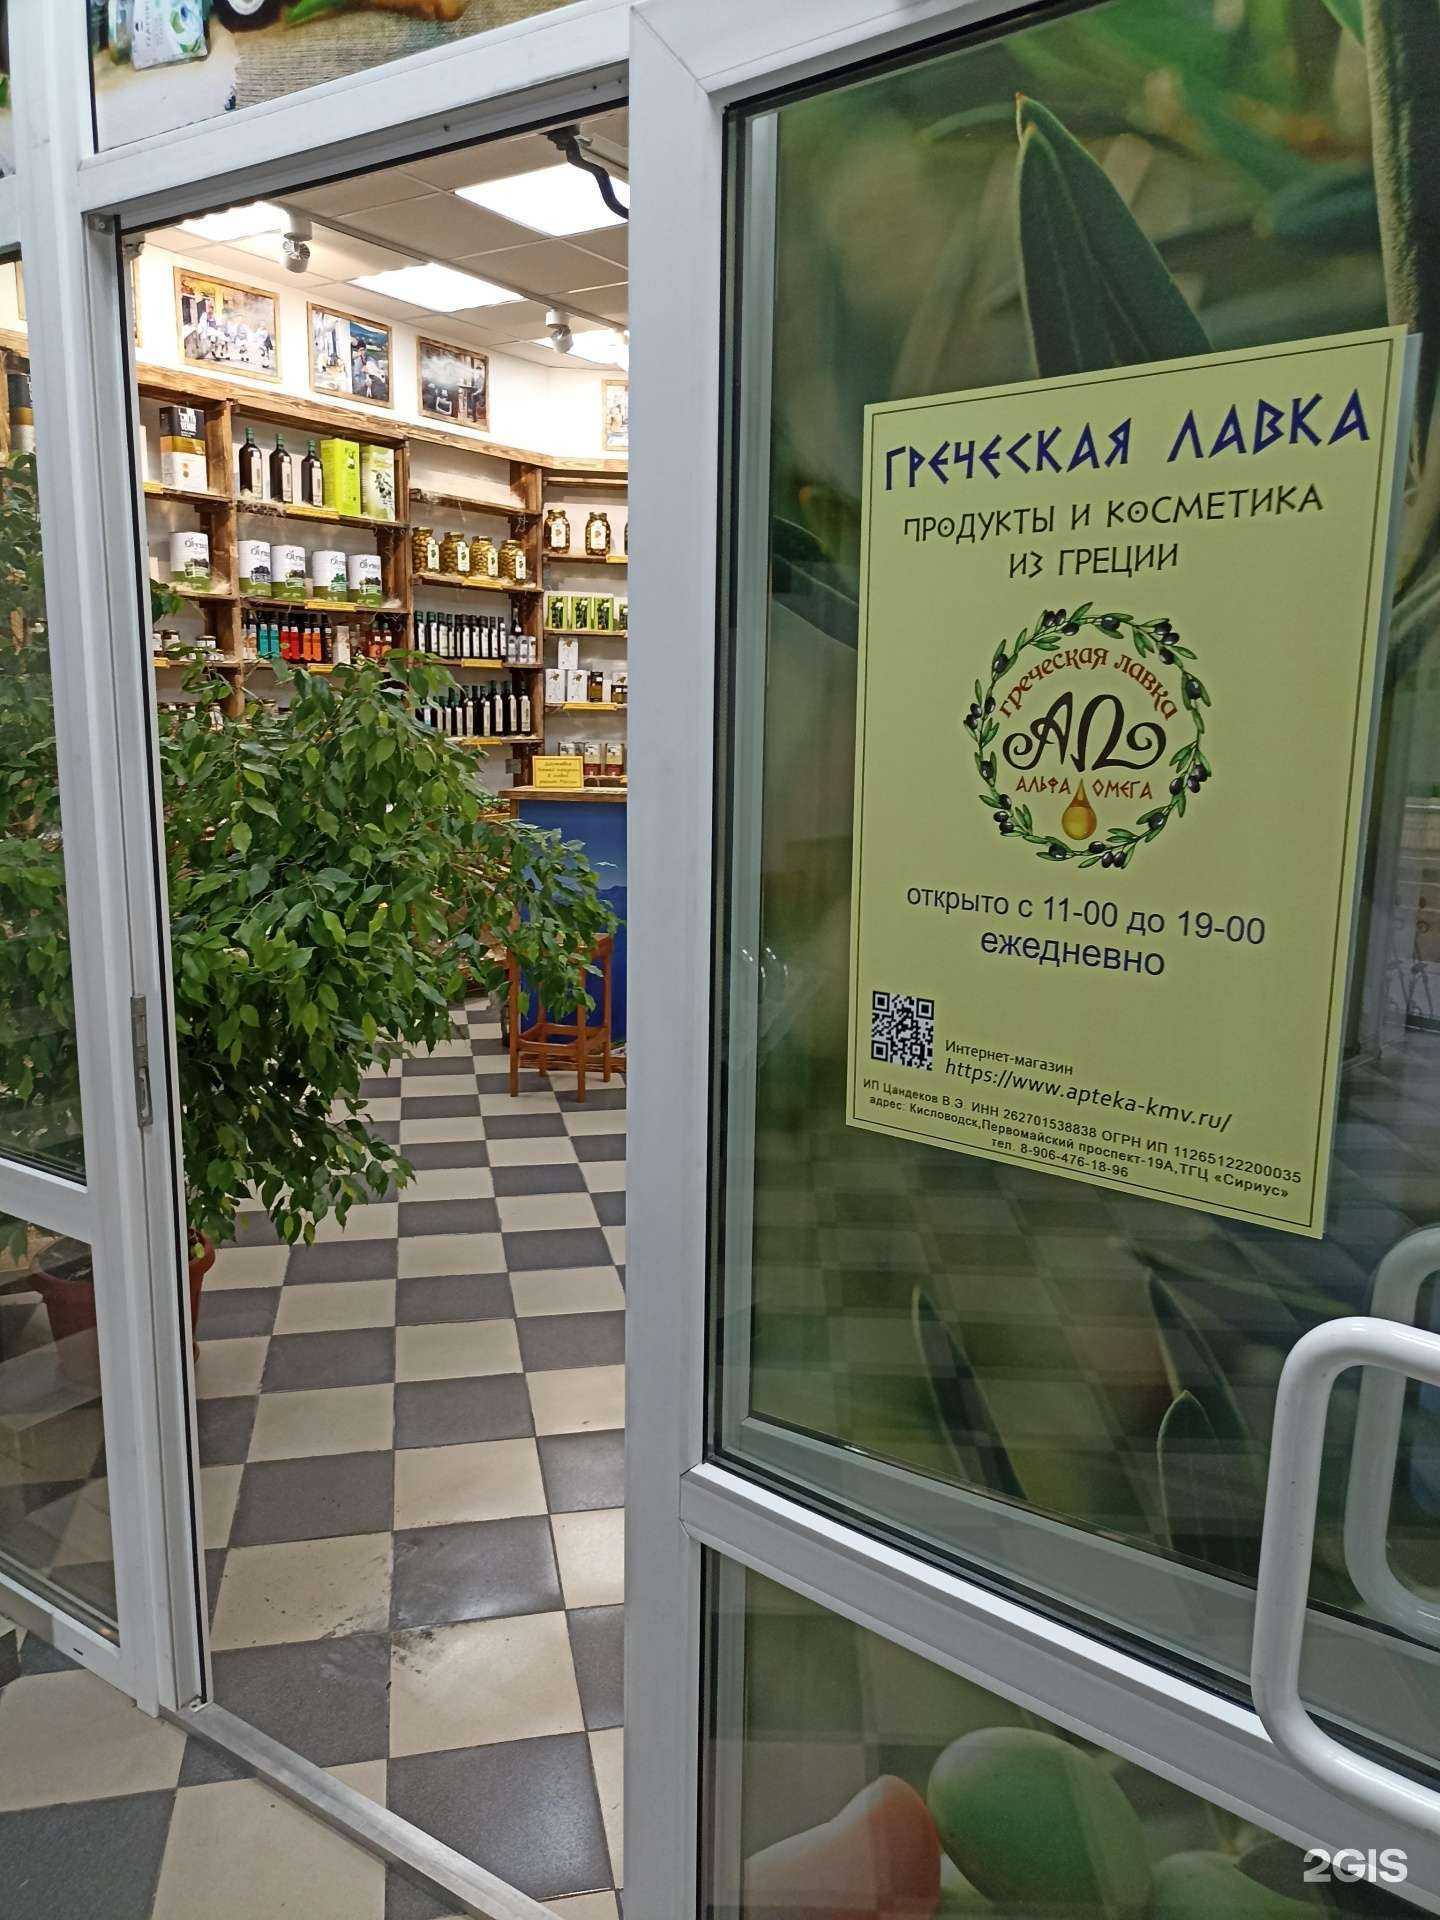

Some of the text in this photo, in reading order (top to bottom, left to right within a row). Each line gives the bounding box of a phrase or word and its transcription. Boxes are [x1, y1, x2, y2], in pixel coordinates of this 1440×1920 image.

[885, 388, 1370, 490] ГРЕЧЕСКАЯ ЛАВКА
[904, 484, 1323, 544] ПРОДУКТЫ И КОСМЕТИКА
[1009, 543, 1178, 579] ИЗ ГРЕЦИИ
[999, 647, 1178, 720] греческая лавка
[1016, 776, 1153, 800] АЛЬФА ОМЕГА
[907, 887, 1265, 944] открыто с 11-00 до 19-00
[980, 932, 1165, 976] ежедневно
[945, 1039, 1073, 1076] Интернет-магазин
[863, 1078, 879, 1090] ИП
[883, 1082, 938, 1103] Цандеков
[971, 1102, 999, 1117] ИНН
[1102, 1131, 1141, 1148] ОГРН
[1146, 1140, 1168, 1153] ИП
[945, 1059, 1232, 1133] https://www.apteka-kmv.ru/
[1020, 1144, 1129, 1177] 8-906-476-18-96
